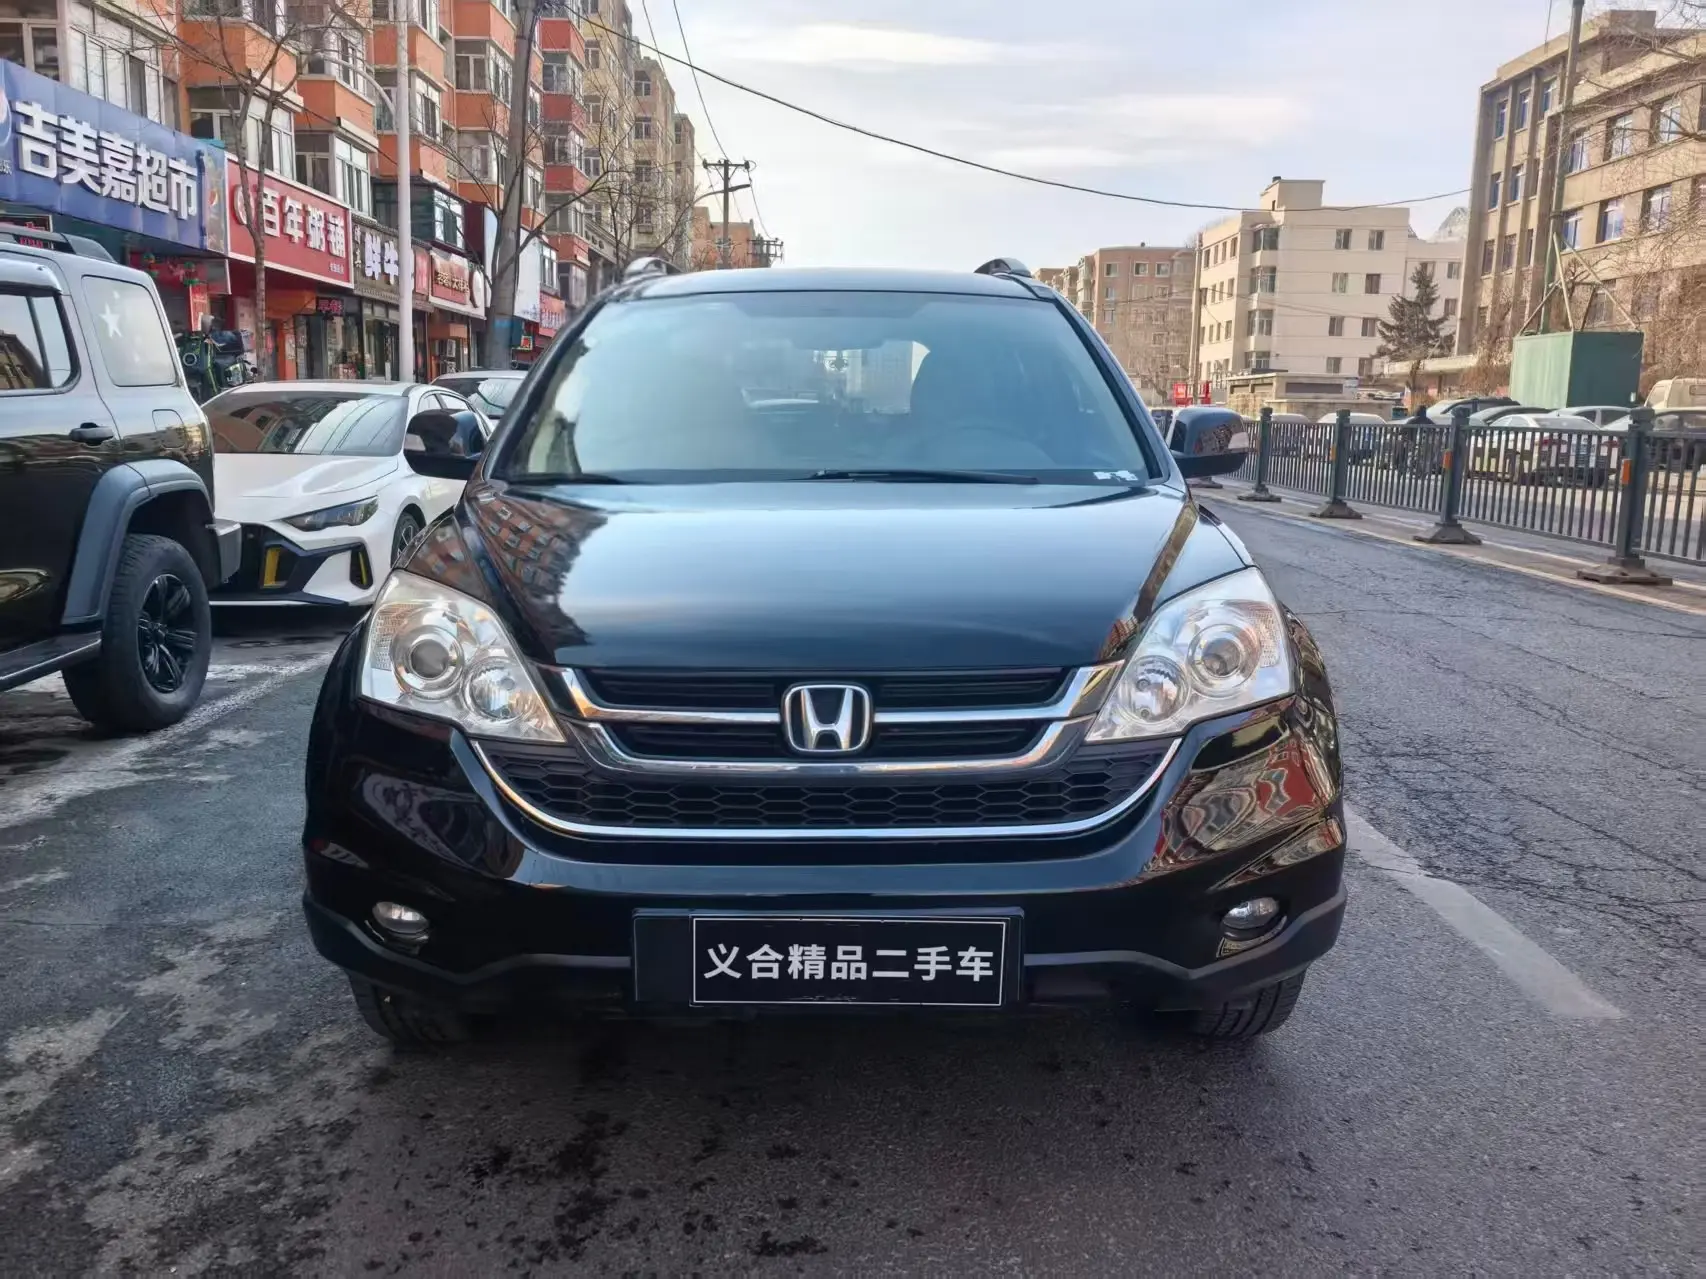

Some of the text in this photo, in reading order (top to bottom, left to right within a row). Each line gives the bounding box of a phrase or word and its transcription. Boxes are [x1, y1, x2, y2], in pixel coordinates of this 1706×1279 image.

[16, 101, 198, 220] 吉美嘉超市
[703, 943, 994, 981] 义合精品二手车
